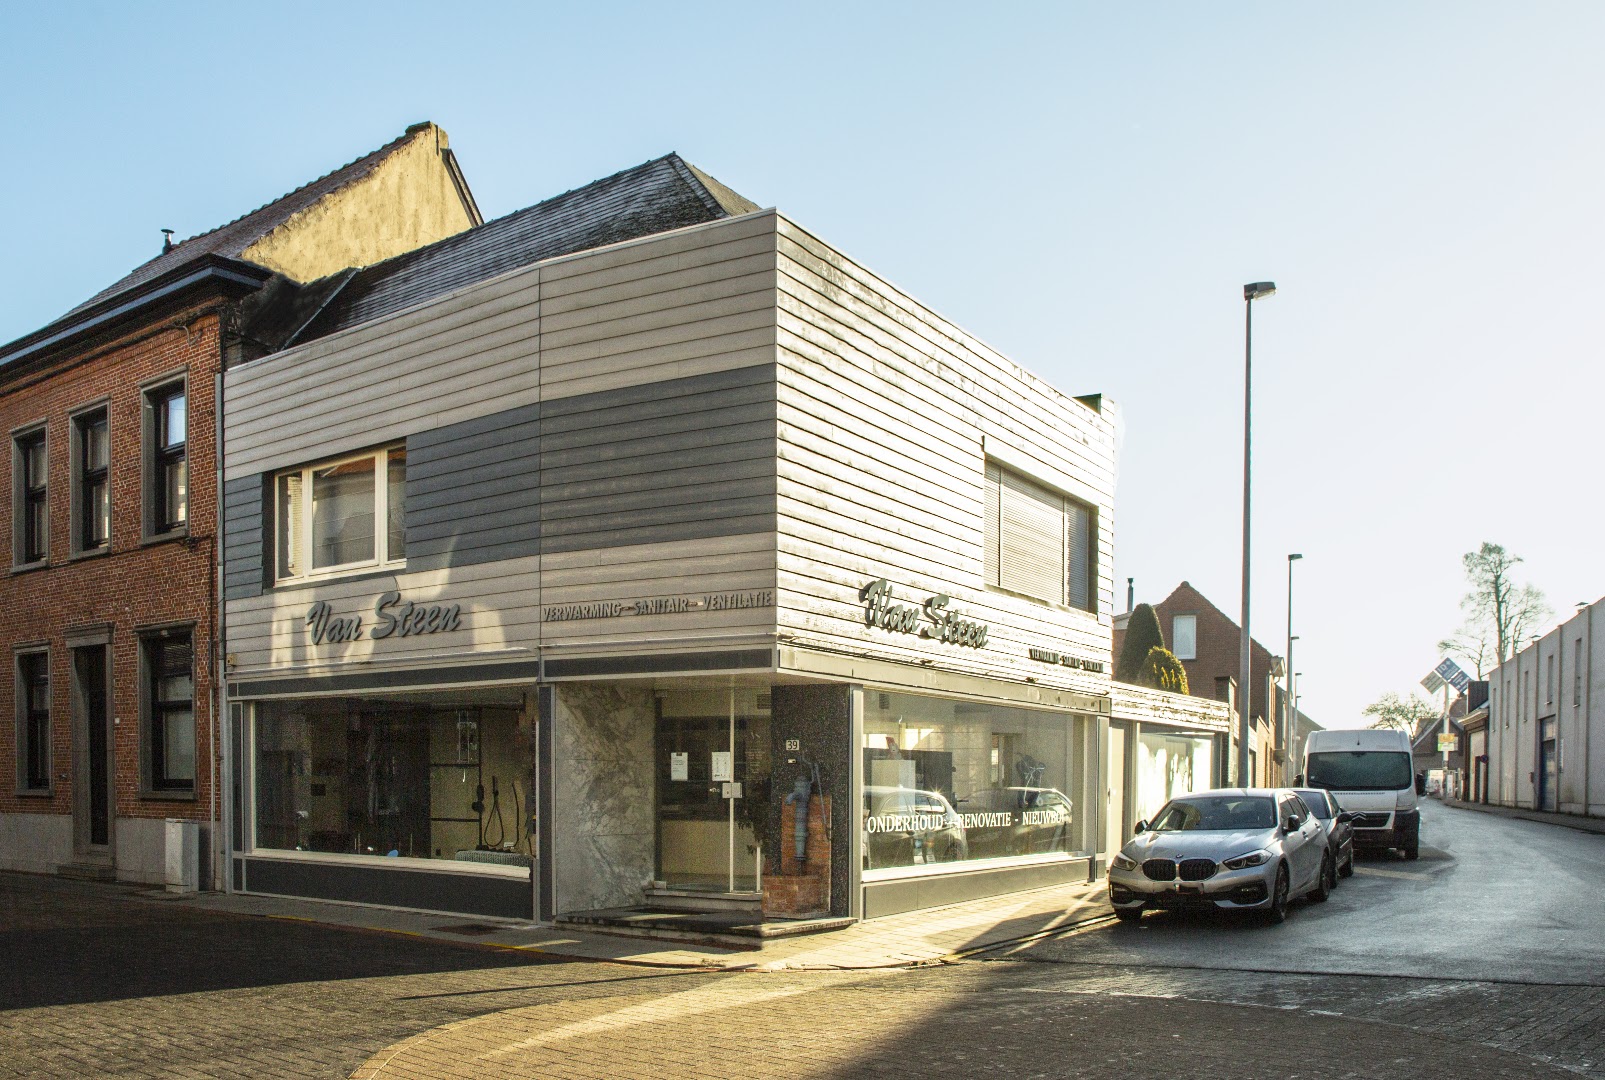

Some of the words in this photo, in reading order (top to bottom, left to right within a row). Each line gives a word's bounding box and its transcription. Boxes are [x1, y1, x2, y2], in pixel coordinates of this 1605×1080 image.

[305, 601, 363, 645] Van
[370, 591, 461, 639] Steen
[543, 601, 622, 622] VERWARMING
[634, 598, 688, 616] SANITAIR
[703, 591, 772, 611] VENTILATIE
[866, 578, 920, 633] Van
[927, 594, 988, 647] Steen
[787, 740, 798, 750] 39
[867, 814, 944, 834] ONDERHOUD
[957, 812, 1012, 829] RENOVATIE
[1022, 810, 1072, 826] NIEUWBO
